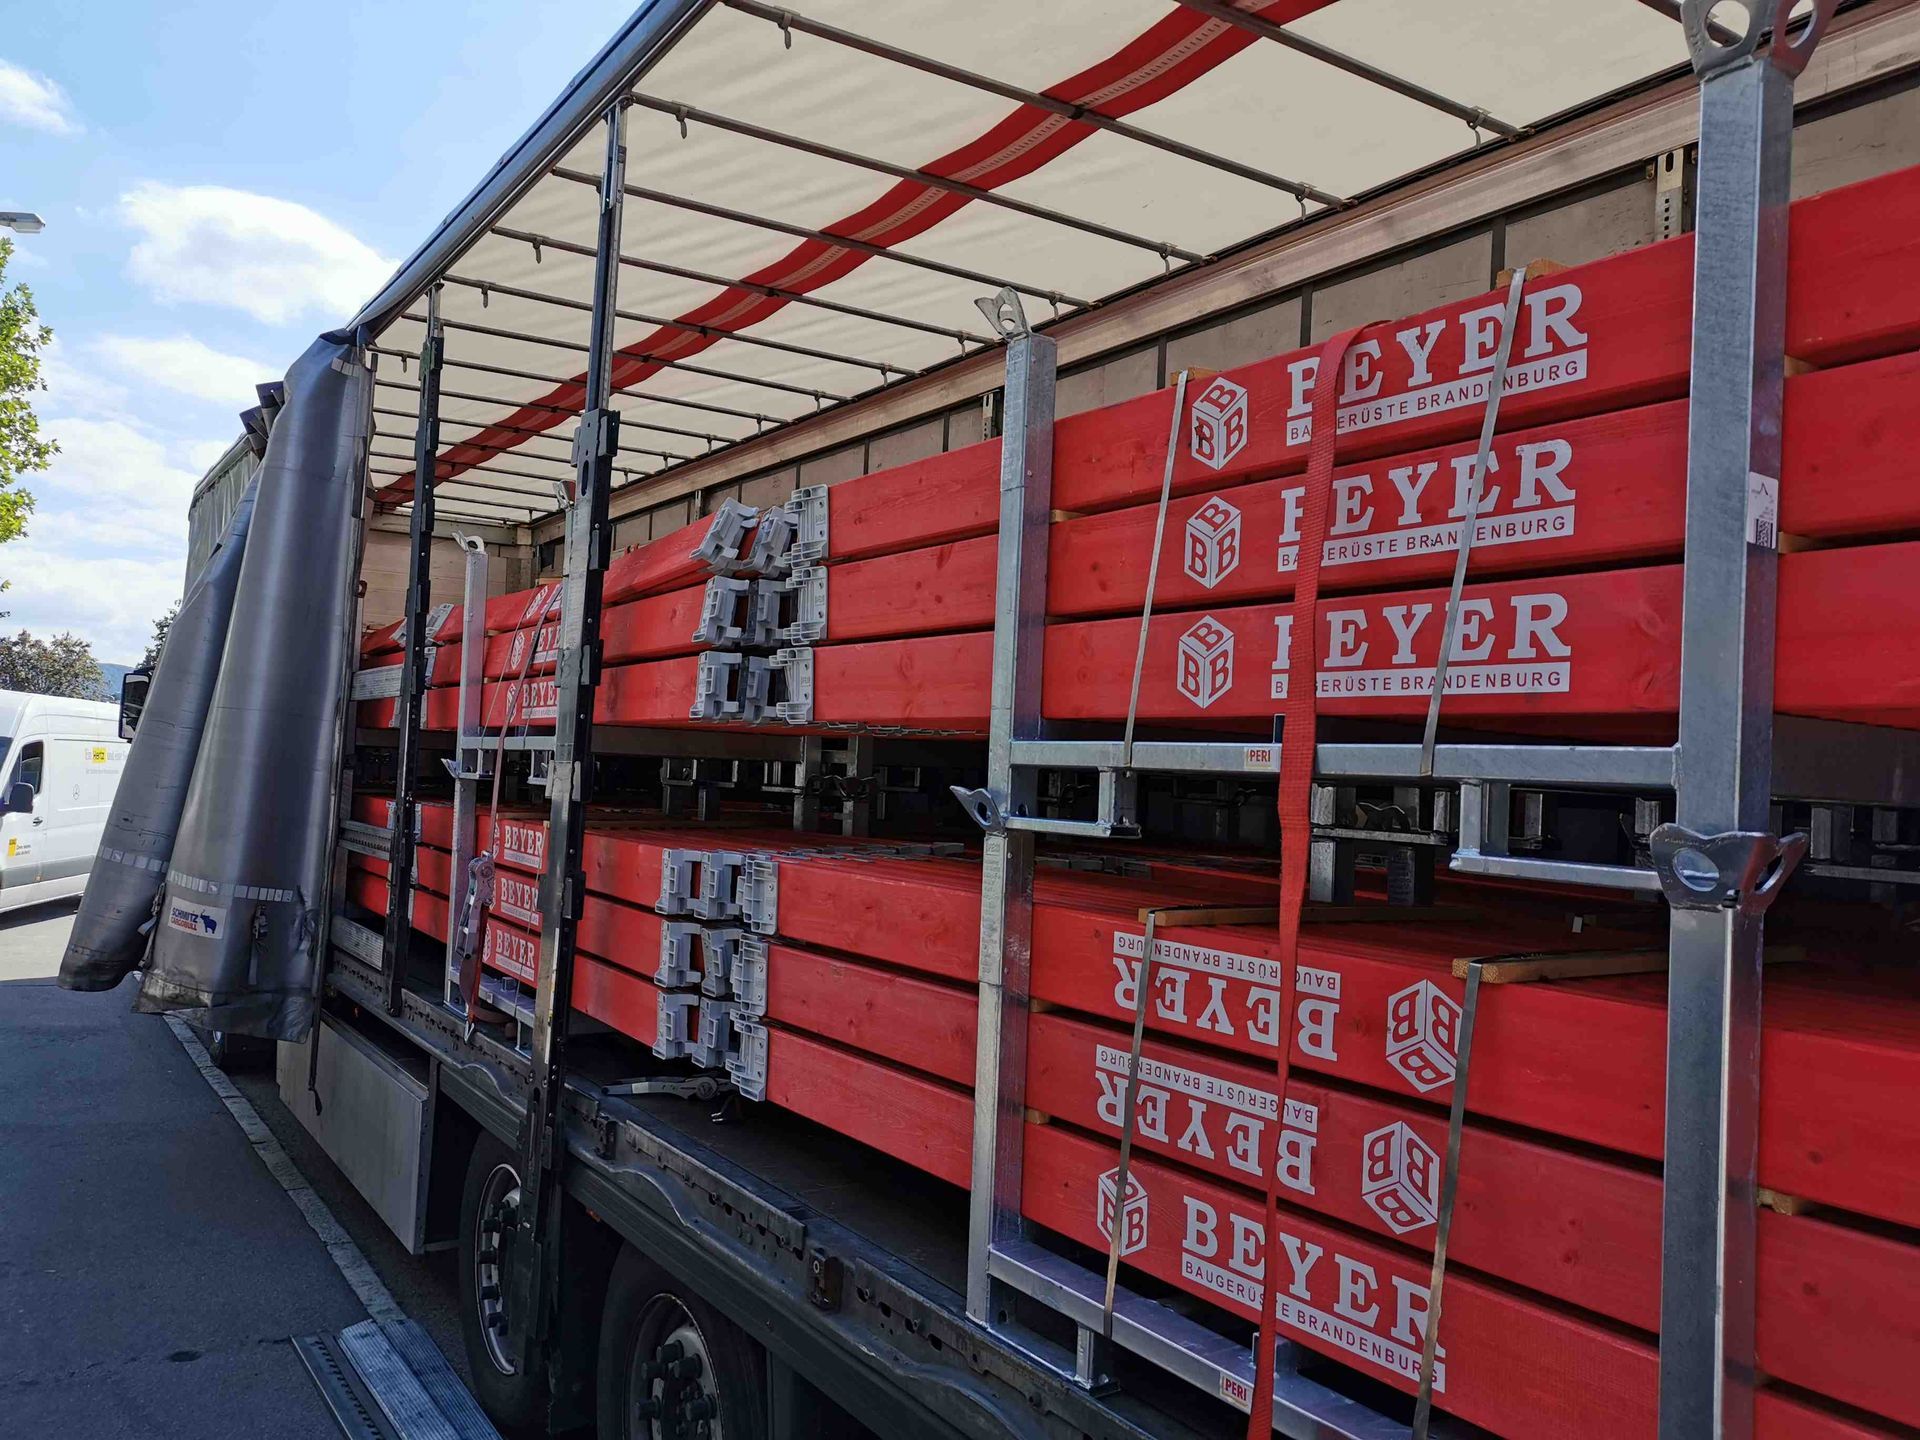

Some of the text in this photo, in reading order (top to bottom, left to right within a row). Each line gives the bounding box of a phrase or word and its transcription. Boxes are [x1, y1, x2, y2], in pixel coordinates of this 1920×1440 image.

[1291, 401, 1408, 440] BAERÜSTE
[1406, 515, 1565, 550] BRANENBURG
[1275, 675, 1392, 693] BERÜSTE
[1249, 749, 1271, 762] PERI
[504, 825, 543, 857] BEYER
[496, 929, 535, 968] BEYER
[1118, 936, 1220, 967] BRANDENURG
[1112, 956, 1341, 1062] BEYER
[1095, 1070, 1316, 1195] BEYER
[1182, 1196, 1446, 1358] BEYER
[1185, 1262, 1290, 1318] BAUGERÜSE
[1225, 1378, 1247, 1401] PERI
